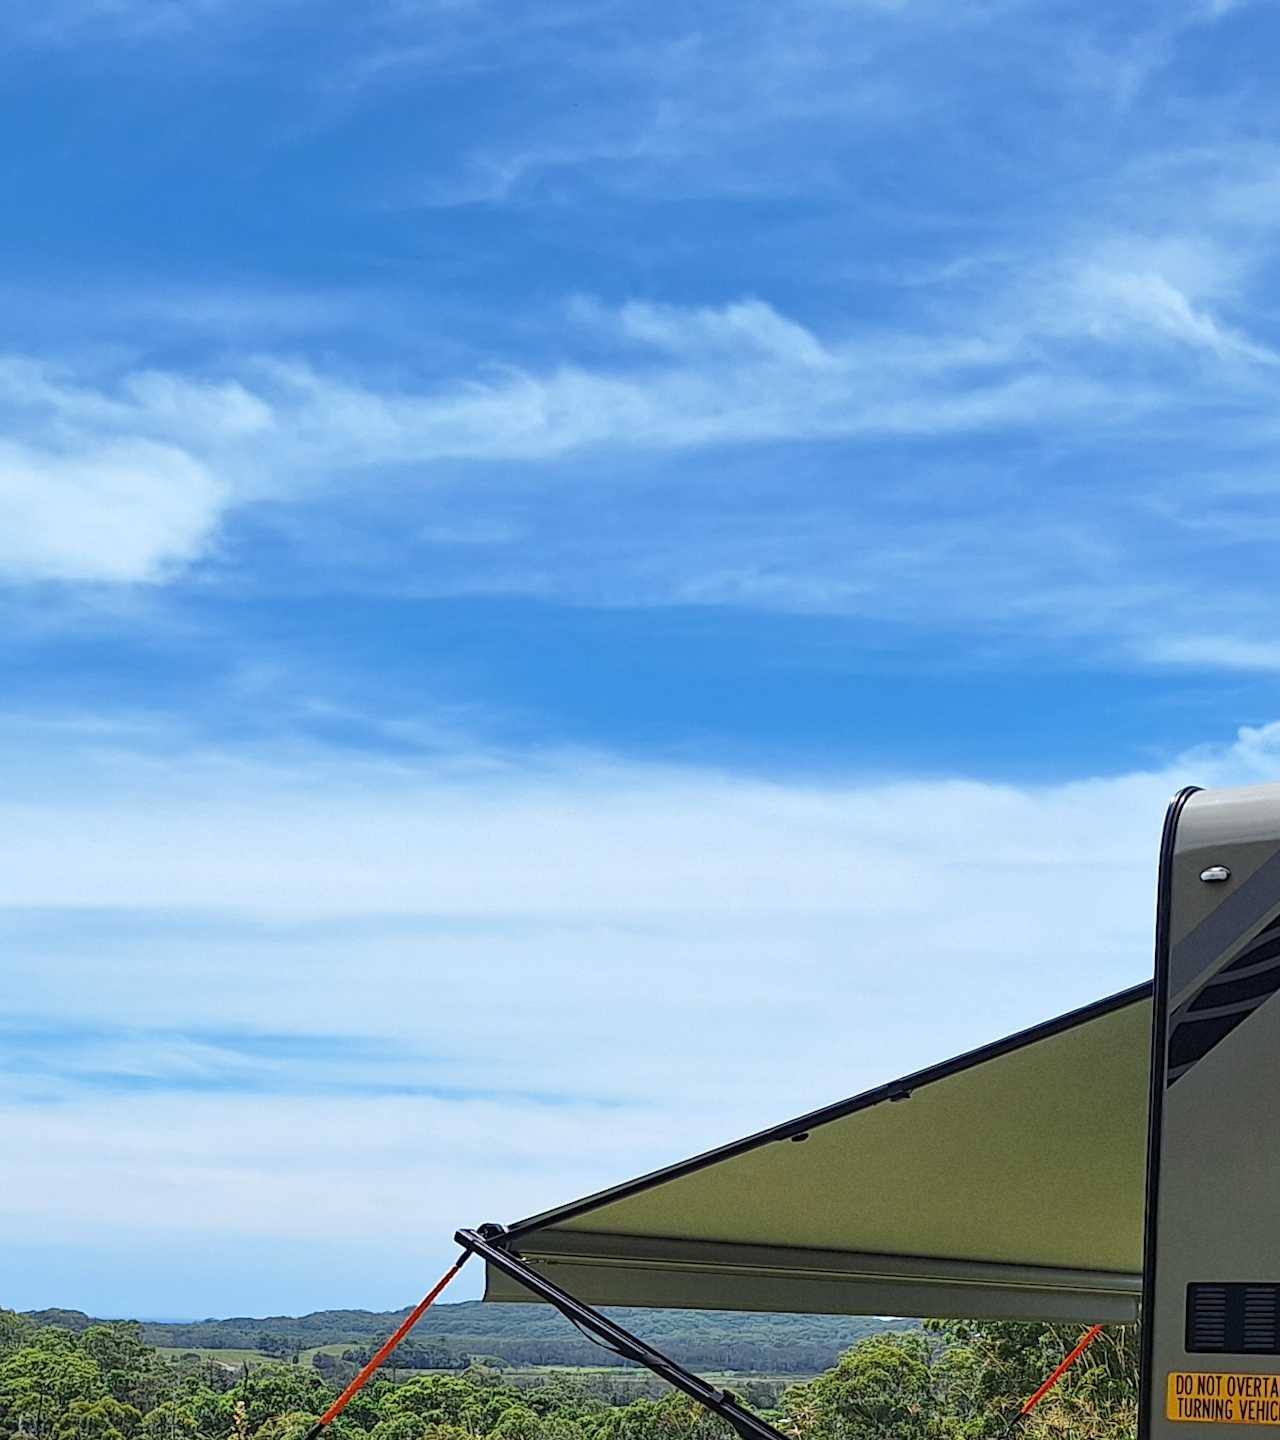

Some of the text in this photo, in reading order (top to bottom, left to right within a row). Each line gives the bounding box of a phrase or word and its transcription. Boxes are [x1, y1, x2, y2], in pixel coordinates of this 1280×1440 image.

[1175, 1374, 1193, 1396] DO
[1197, 1375, 1222, 1397] NOT
[1177, 1397, 1233, 1420] TURNING
